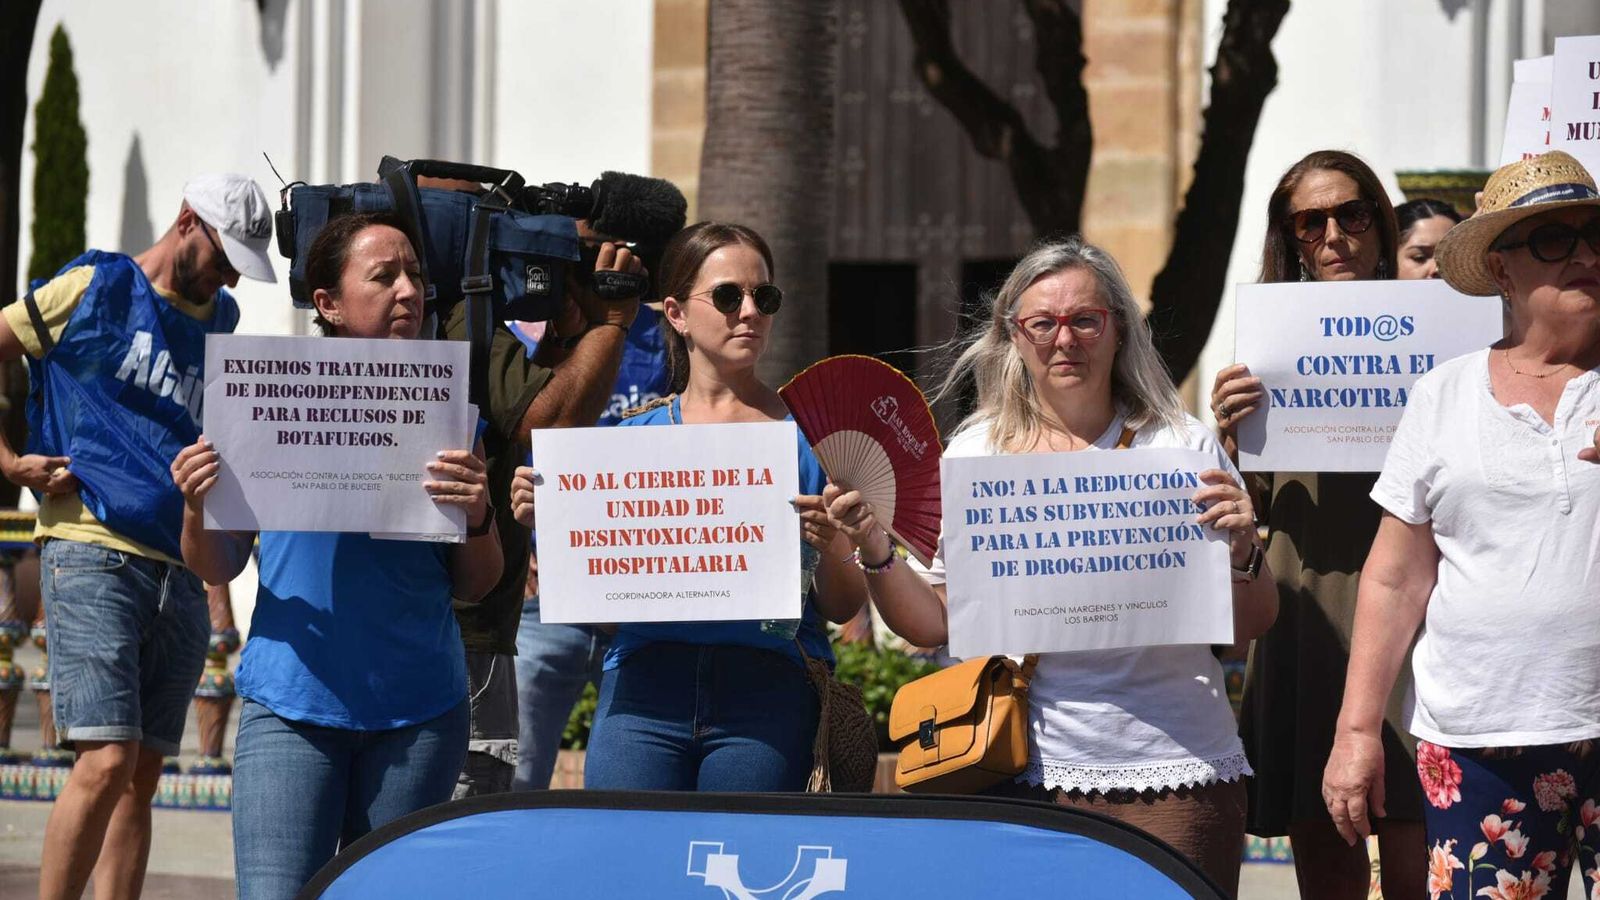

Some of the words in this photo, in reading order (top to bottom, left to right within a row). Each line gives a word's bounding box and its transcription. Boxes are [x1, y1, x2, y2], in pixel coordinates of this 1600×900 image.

[1320, 314, 1415, 342] TOD@S
[223, 359, 311, 377] EXIGIMOS
[316, 361, 453, 379] TRATAMIENTOS
[1296, 354, 1402, 376] CONTRA
[225, 382, 249, 398] DE
[254, 383, 450, 402] DROGODEPENDENCIAS
[1270, 387, 1409, 408] NARCOTRA
[252, 406, 300, 422] PARA
[306, 408, 397, 424] RECLUSOS
[402, 410, 425, 425] DE
[276, 430, 399, 447] BOTAFUEGOS.
[1284, 424, 1336, 434] ASOCIACIÓN
[1338, 425, 1372, 433] CONTRA
[1374, 425, 1385, 433] LA
[1386, 425, 1398, 433] DR
[1327, 435, 1344, 443] SAN
[1345, 435, 1371, 443] PABLO
[1373, 435, 1385, 443] DE
[249, 470, 304, 481] ASOCIACIÓN
[305, 472, 339, 481] CONTRA
[340, 472, 350, 481] LA
[352, 472, 383, 481] DROGA
[558, 473, 587, 491] NO
[592, 472, 619, 490] AL
[624, 470, 705, 490] CIERRE
[712, 469, 740, 487] DE
[747, 468, 773, 486] LA
[972, 480, 1016, 498] ¡NO!
[1022, 479, 1037, 496] A
[1042, 478, 1068, 494] LA
[1074, 468, 1198, 493] REDUCCIÓN
[291, 482, 309, 490] SAN
[310, 482, 337, 490] PABLO
[339, 482, 350, 491] DE
[351, 483, 381, 491] BUCEITE
[606, 499, 690, 519] UNIDAD
[696, 498, 724, 516] DE
[965, 508, 993, 525] DE
[999, 506, 1037, 523] LAS
[569, 521, 765, 548] DESINTOXICACIÓN
[971, 533, 1029, 551] PARA
[1035, 531, 1061, 549] LA
[1067, 521, 1204, 547] PREVENCIÓN
[587, 554, 748, 575] HOSPITALARIA
[991, 560, 1019, 578] DE
[1025, 549, 1186, 576] DROGADICCIÓN
[605, 591, 673, 601] COORDINADORA
[675, 590, 731, 599] ALTERNATIVAS
[1014, 605, 1067, 617] FUNDACIÓN
[1068, 603, 1116, 614] MARGENES
[1117, 602, 1124, 611] Y
[1125, 600, 1168, 611] VINCULOS
[1064, 615, 1081, 625] LOS
[1083, 613, 1119, 624] BARRIOS
